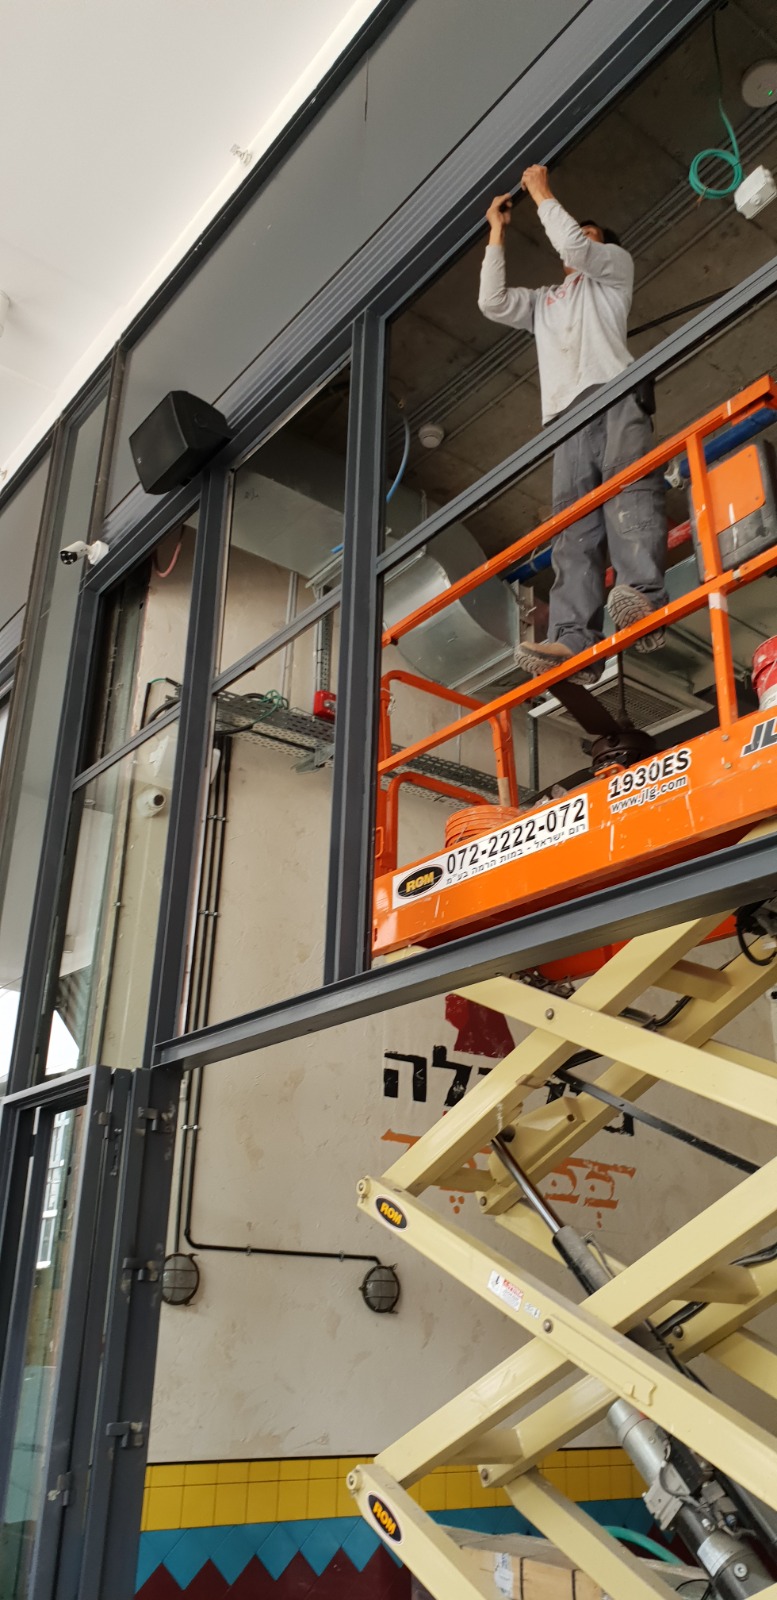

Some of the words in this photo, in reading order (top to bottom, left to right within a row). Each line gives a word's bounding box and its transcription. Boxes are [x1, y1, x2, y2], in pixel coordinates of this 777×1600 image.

[609, 749, 690, 799] 1930ES
[610, 775, 687, 813] www.jlg.com
[447, 798, 586, 875] 072-2222-072
[533, 831, 565, 849] ישראל
[405, 871, 435, 893] ROM
[380, 1201, 403, 1225] ROM
[373, 1501, 397, 1535] ROM
